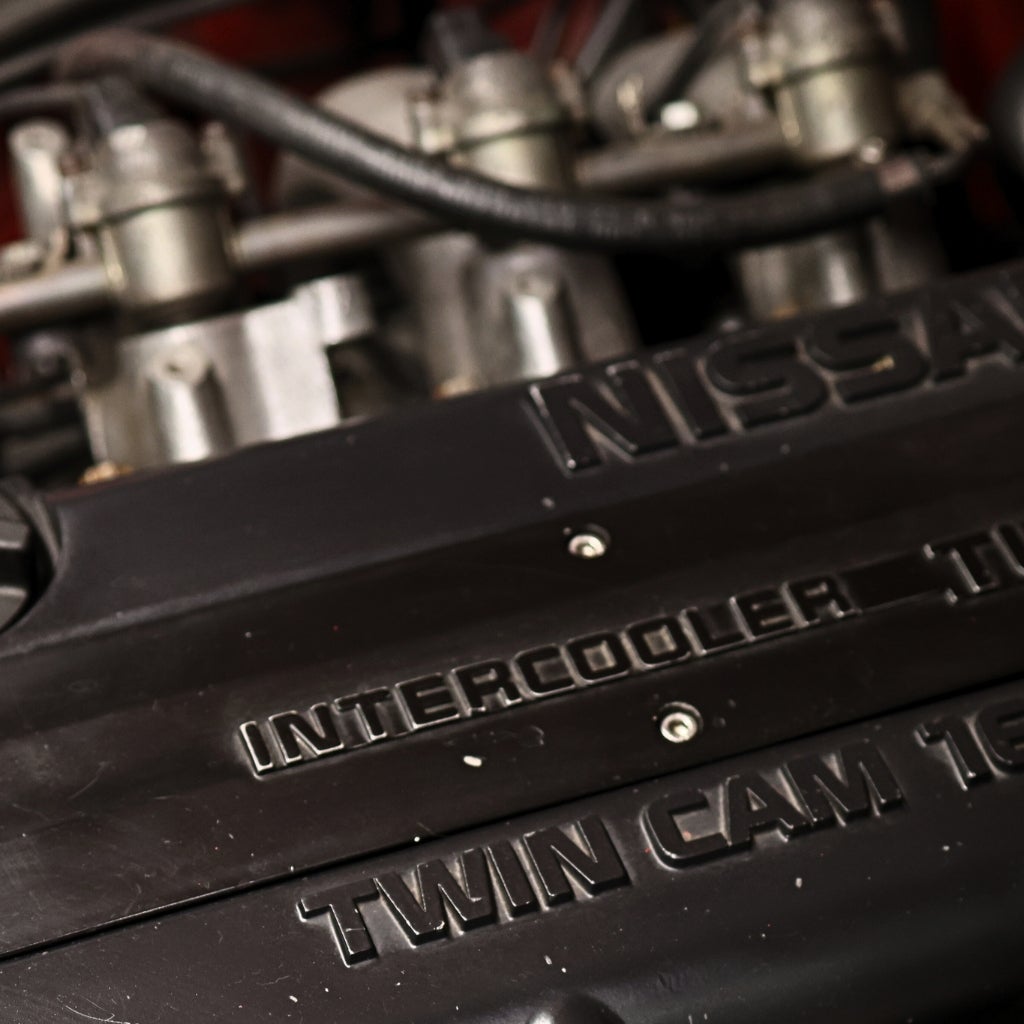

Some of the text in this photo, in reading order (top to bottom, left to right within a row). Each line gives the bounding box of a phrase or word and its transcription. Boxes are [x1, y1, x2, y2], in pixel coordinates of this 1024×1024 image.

[238, 575, 858, 778] INTERCOOLER
[297, 814, 632, 966] TWIN
[641, 739, 904, 870] CAM
